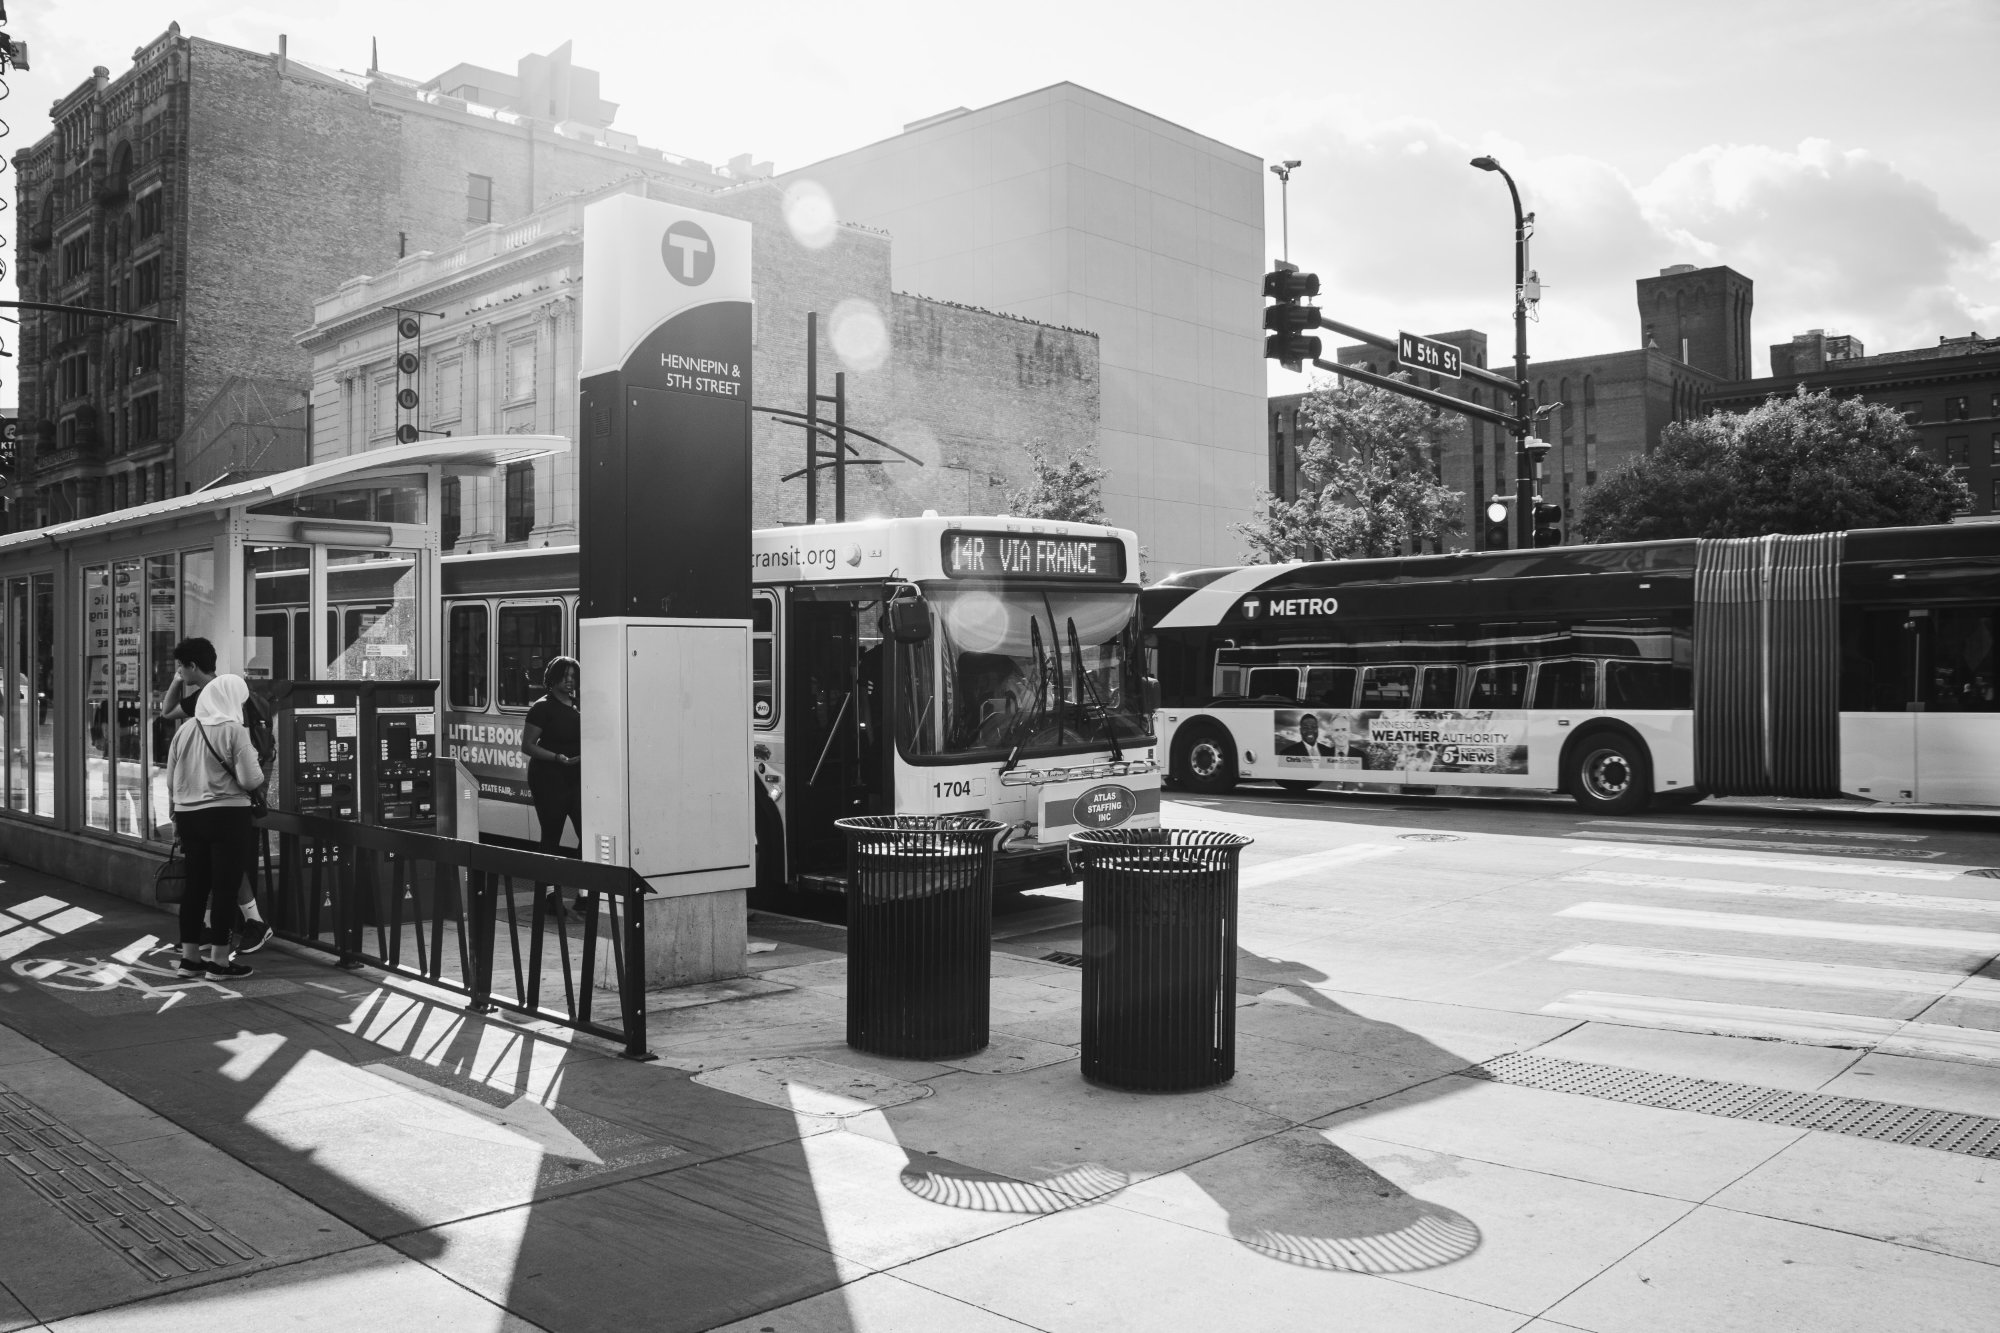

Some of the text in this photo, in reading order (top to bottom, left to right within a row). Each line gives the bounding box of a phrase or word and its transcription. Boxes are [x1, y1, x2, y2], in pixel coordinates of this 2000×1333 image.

[1403, 339, 1457, 370] N 5th St
[661, 353, 741, 377] HENNEPIN &
[666, 373, 741, 395] 5TH STREET
[952, 536, 1097, 574] 14R VIA FRANCE
[1243, 597, 1338, 617] T METRO
[449, 723, 485, 743] LITTLE
[487, 726, 523, 746] BOOK
[1371, 730, 1509, 743] WEATHER AUTHORITY
[449, 744, 527, 769] BIG SAVINGS.
[1460, 752, 1495, 763] NEWS
[481, 783, 498, 793] STATE
[933, 780, 971, 798] 1704
[1093, 792, 1117, 803] ATLAS
[1087, 801, 1122, 814] STAFFING
[1098, 813, 1112, 822] INC
